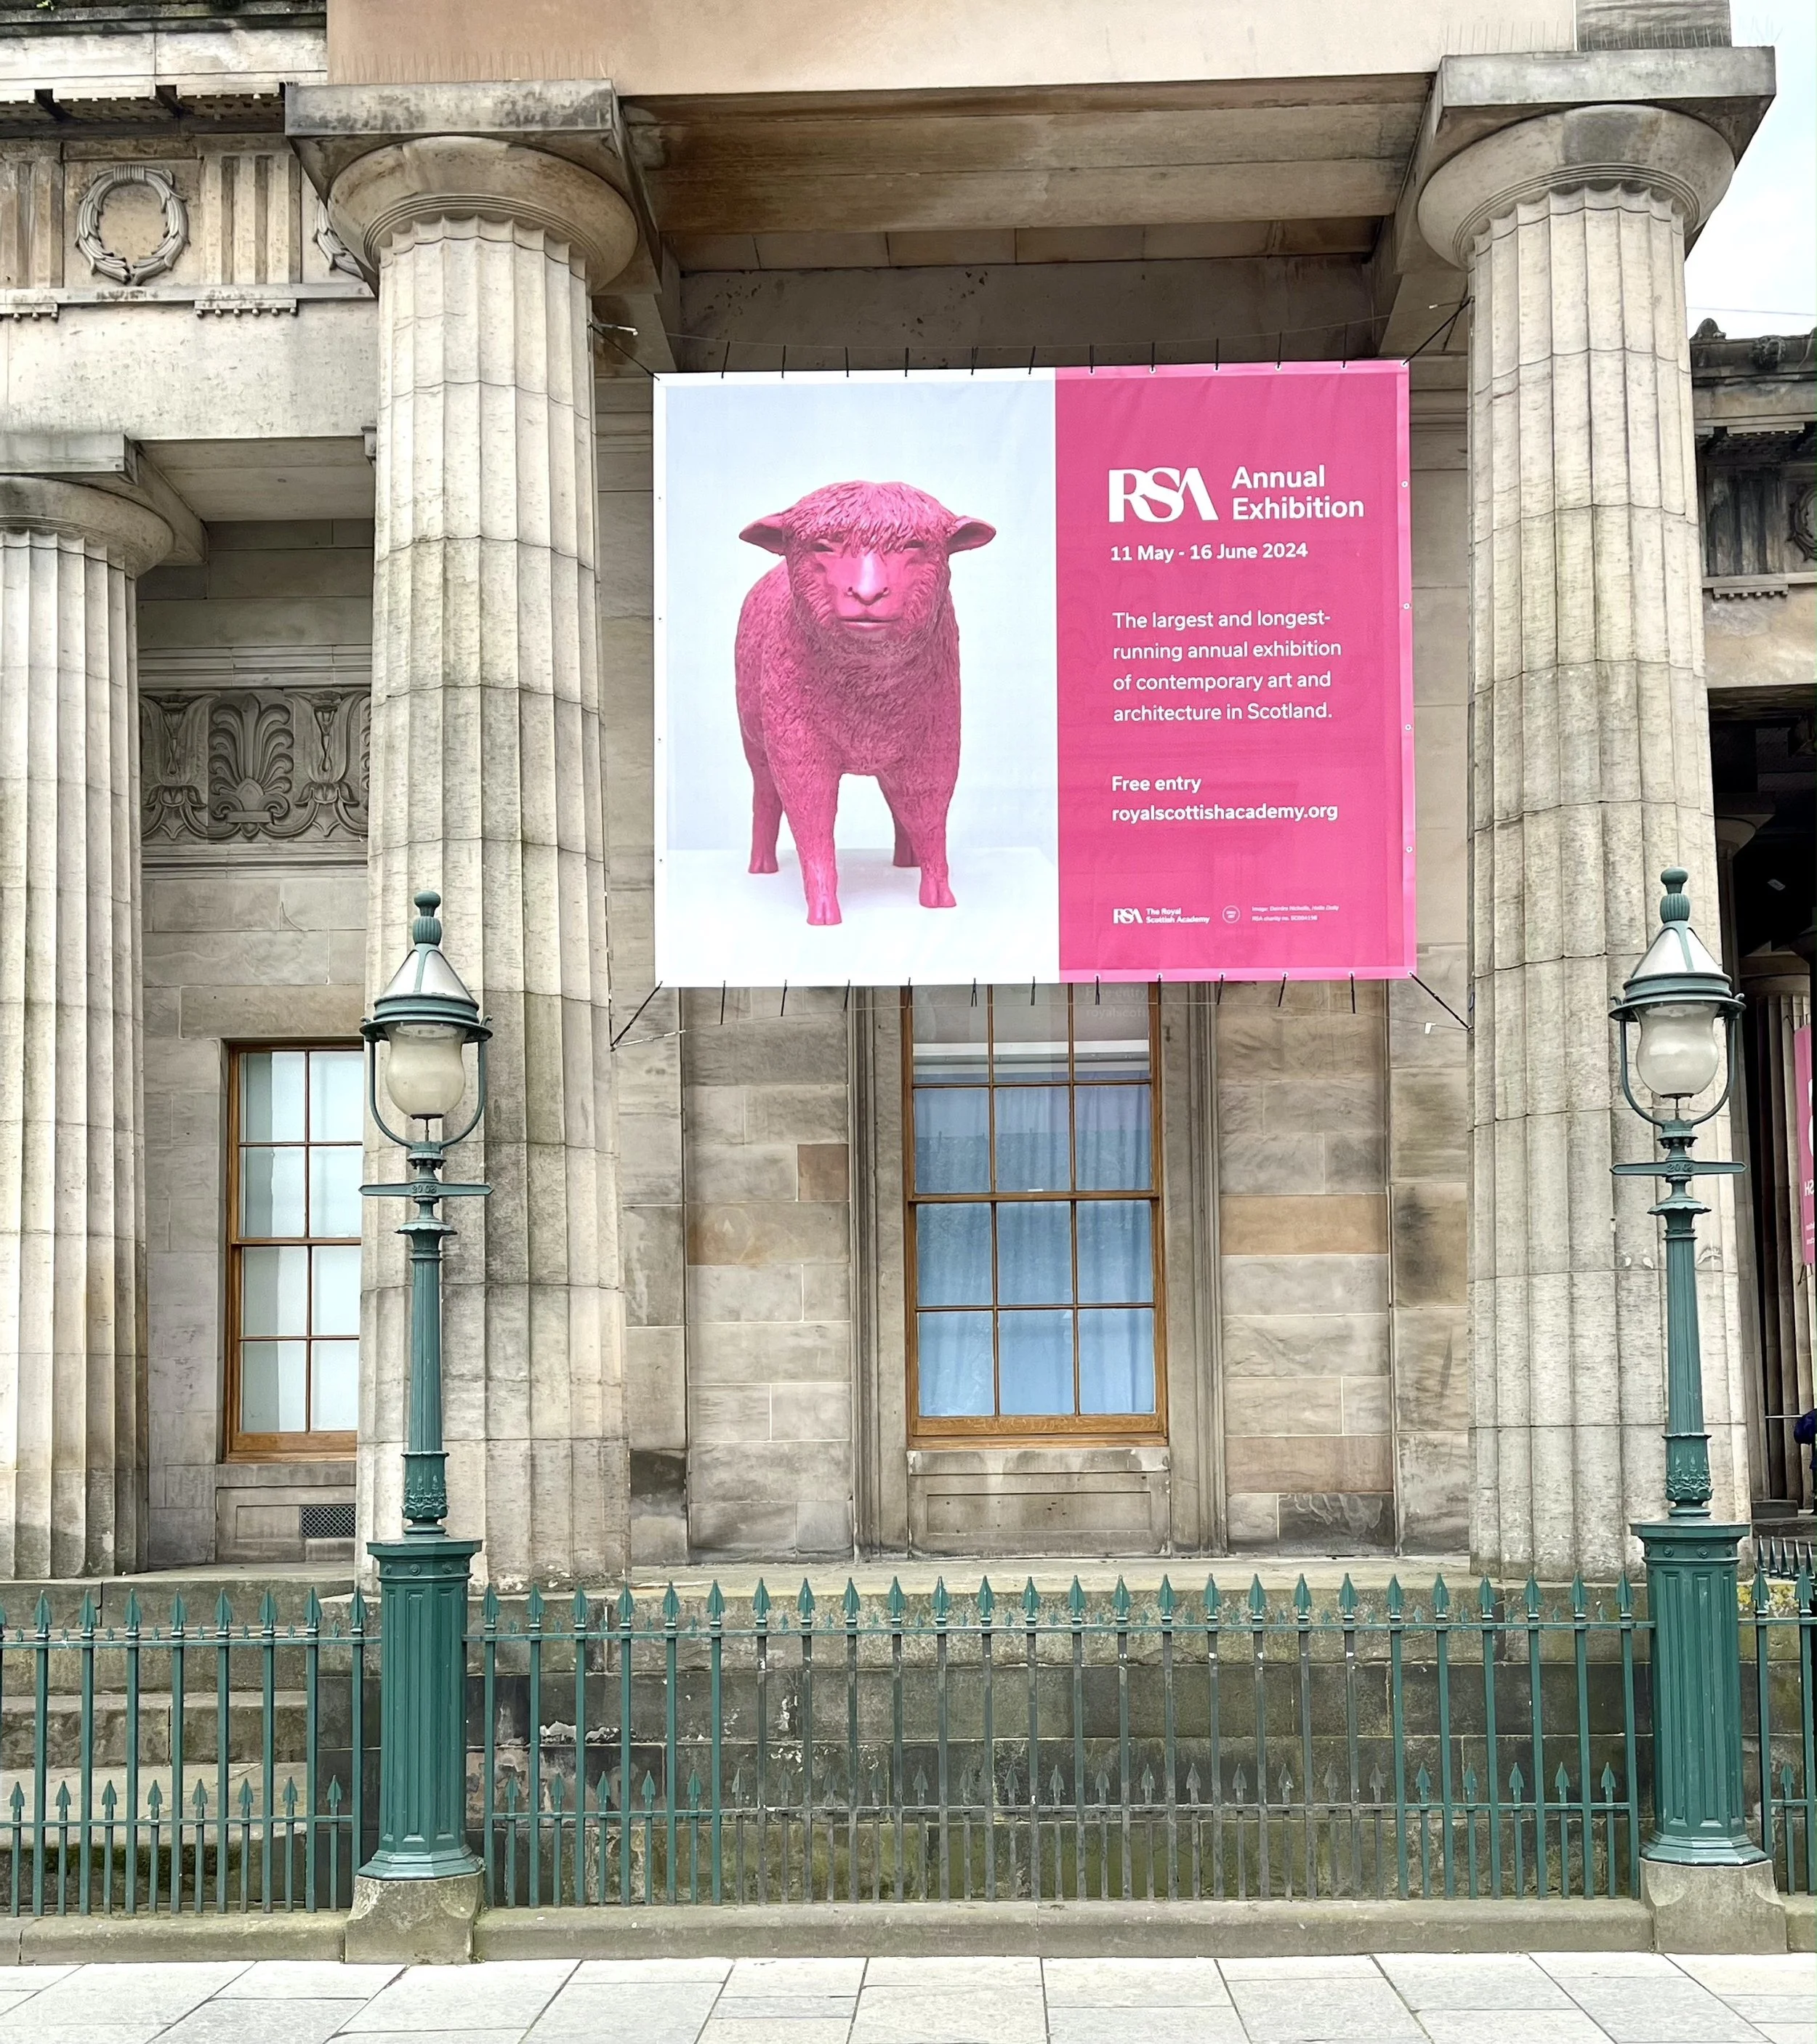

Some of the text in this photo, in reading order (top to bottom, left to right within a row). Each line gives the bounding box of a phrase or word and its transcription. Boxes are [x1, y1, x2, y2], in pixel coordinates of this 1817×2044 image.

[1231, 464, 1325, 490] Annual
[1108, 467, 1219, 523] RSA
[1233, 495, 1365, 520] Exhibition
[1111, 546, 1132, 561] 11
[1137, 545, 1175, 563] May
[1190, 544, 1213, 560] 16
[1216, 544, 1258, 560] June
[1262, 543, 1309, 559] 2024
[1112, 610, 1331, 631] The largest and longest-
[1113, 639, 1342, 663] running annual exhibition
[1113, 671, 1331, 692] of contemporary art and
[1113, 701, 1332, 722] architecture in Scotland.
[1112, 775, 1202, 794] Free entry
[1112, 803, 1338, 825] royalscottishacademy.org
[1113, 908, 1143, 924] RSA
[1145, 915, 1210, 924] Scottish Academy
[1161, 907, 1182, 916] Royal
